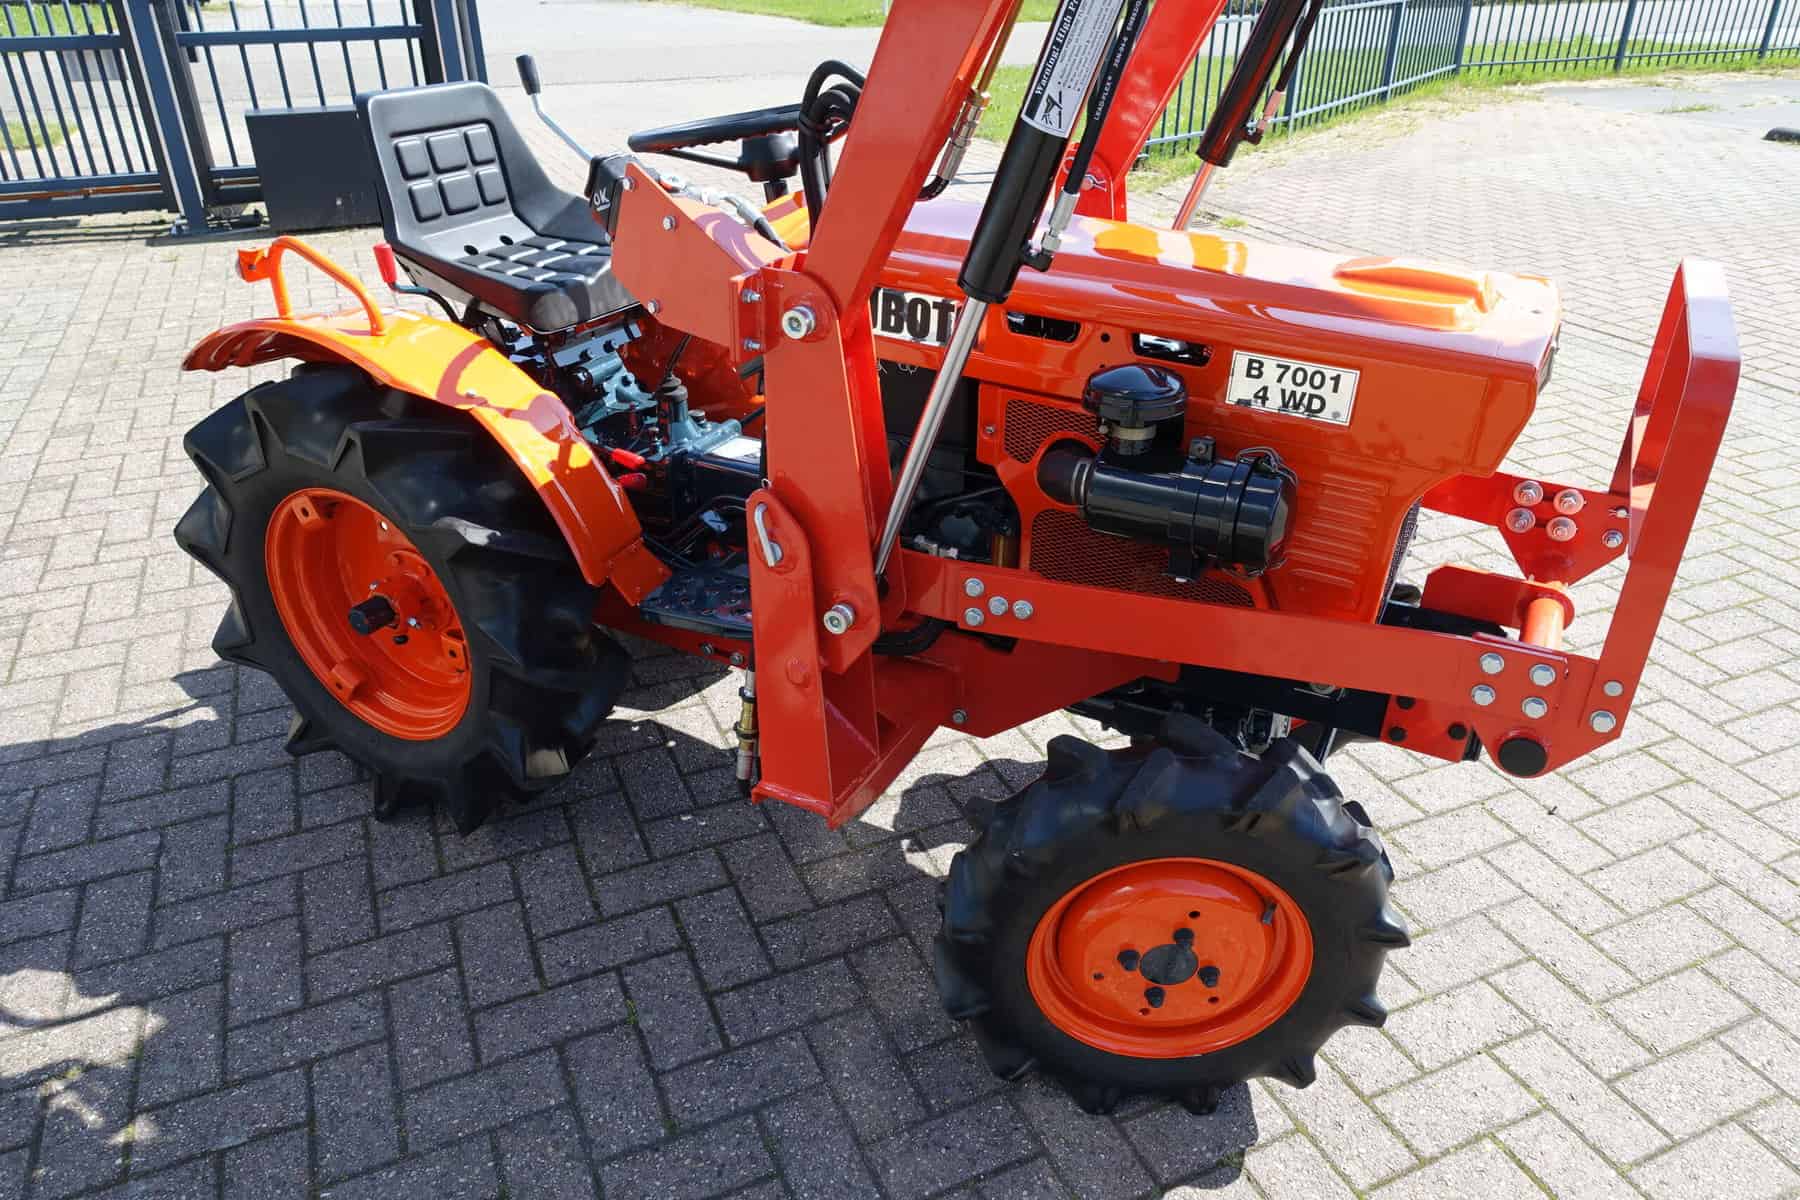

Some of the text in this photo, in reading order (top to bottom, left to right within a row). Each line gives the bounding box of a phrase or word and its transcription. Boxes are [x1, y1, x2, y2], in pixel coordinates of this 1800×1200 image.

[1035, 46, 1060, 96] Warning!
[1055, 16, 1073, 43] High
[593, 187, 610, 206] OK
[869, 286, 962, 342] BOT
[1245, 358, 1342, 394] B 7001
[1253, 385, 1326, 414] 4 WD
